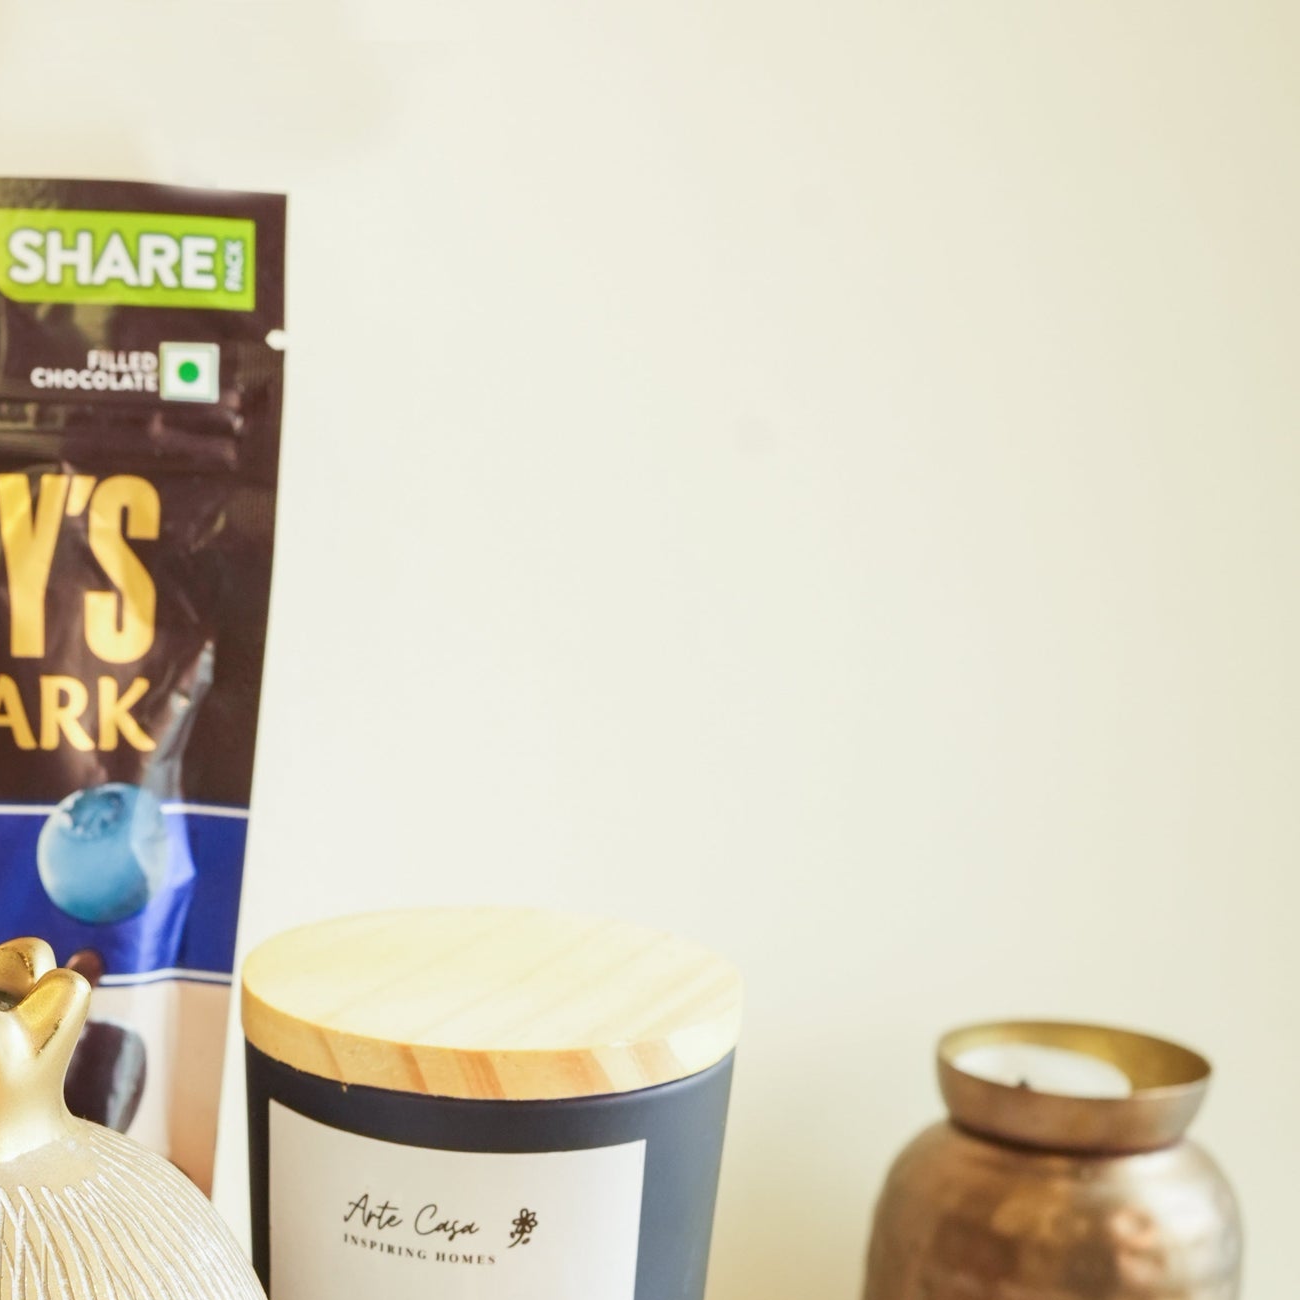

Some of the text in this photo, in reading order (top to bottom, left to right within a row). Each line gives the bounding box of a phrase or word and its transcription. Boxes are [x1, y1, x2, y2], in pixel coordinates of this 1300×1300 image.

[8, 228, 217, 290] SHARE
[87, 350, 158, 373] FILLED
[29, 366, 158, 392] CHOCOLATE
[343, 1193, 480, 1242] Arte Casa
[343, 1233, 496, 1265] INSPIRING HOMES
